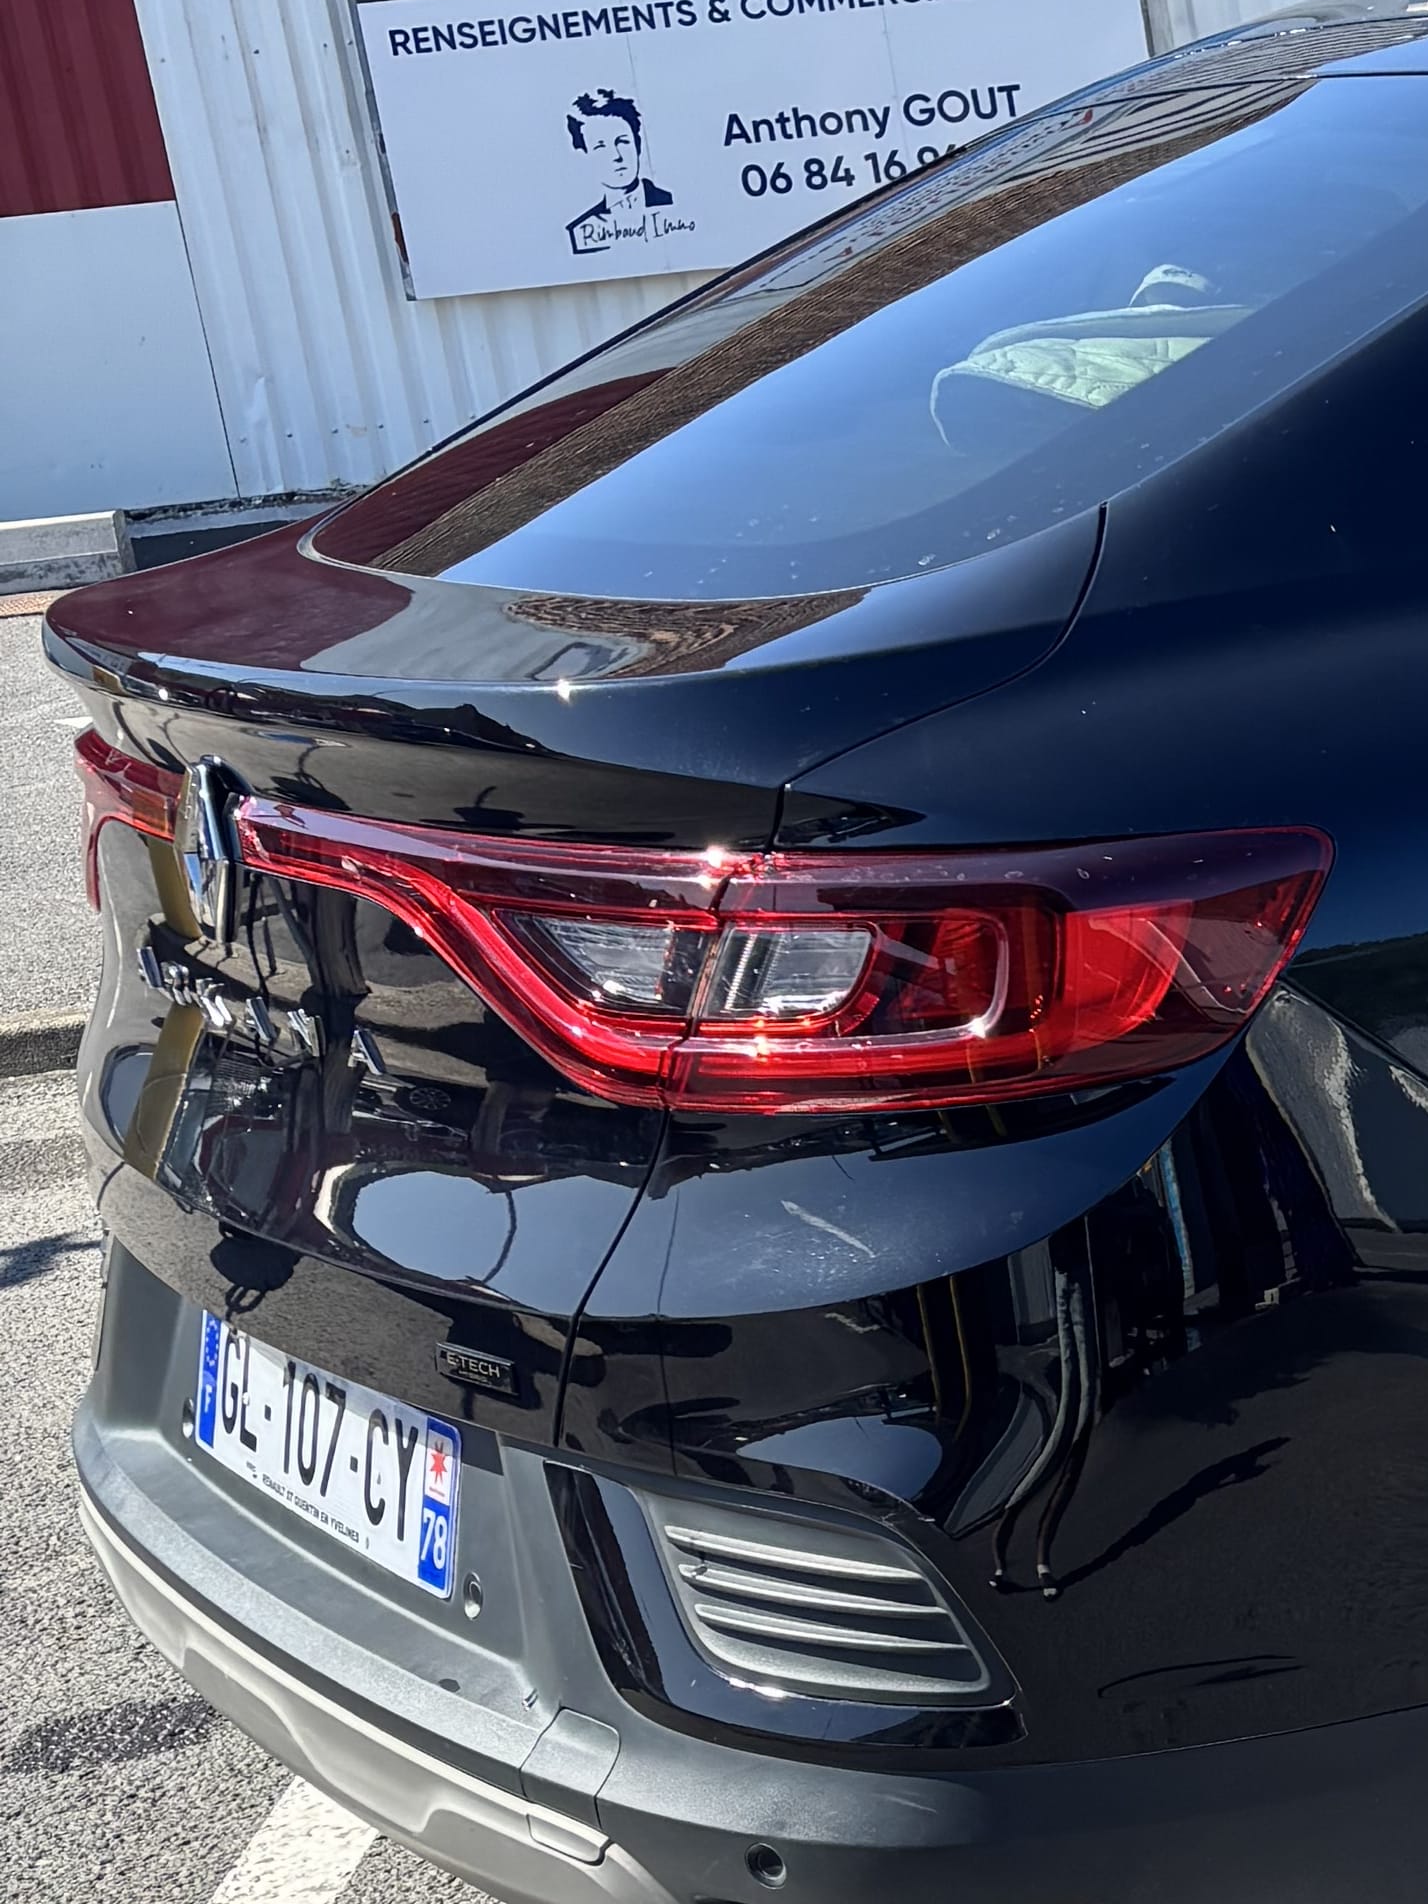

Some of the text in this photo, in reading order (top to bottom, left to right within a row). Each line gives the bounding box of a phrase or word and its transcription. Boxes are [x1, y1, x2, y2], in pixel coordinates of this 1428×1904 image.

[724, 84, 1021, 147] Anthony GOUT
[741, 161, 793, 197] 06
[803, 155, 855, 191] 84
[864, 149, 907, 184] 16
[221, 1329, 419, 1542] GL-107-CY
[420, 1506, 448, 1570] 78
